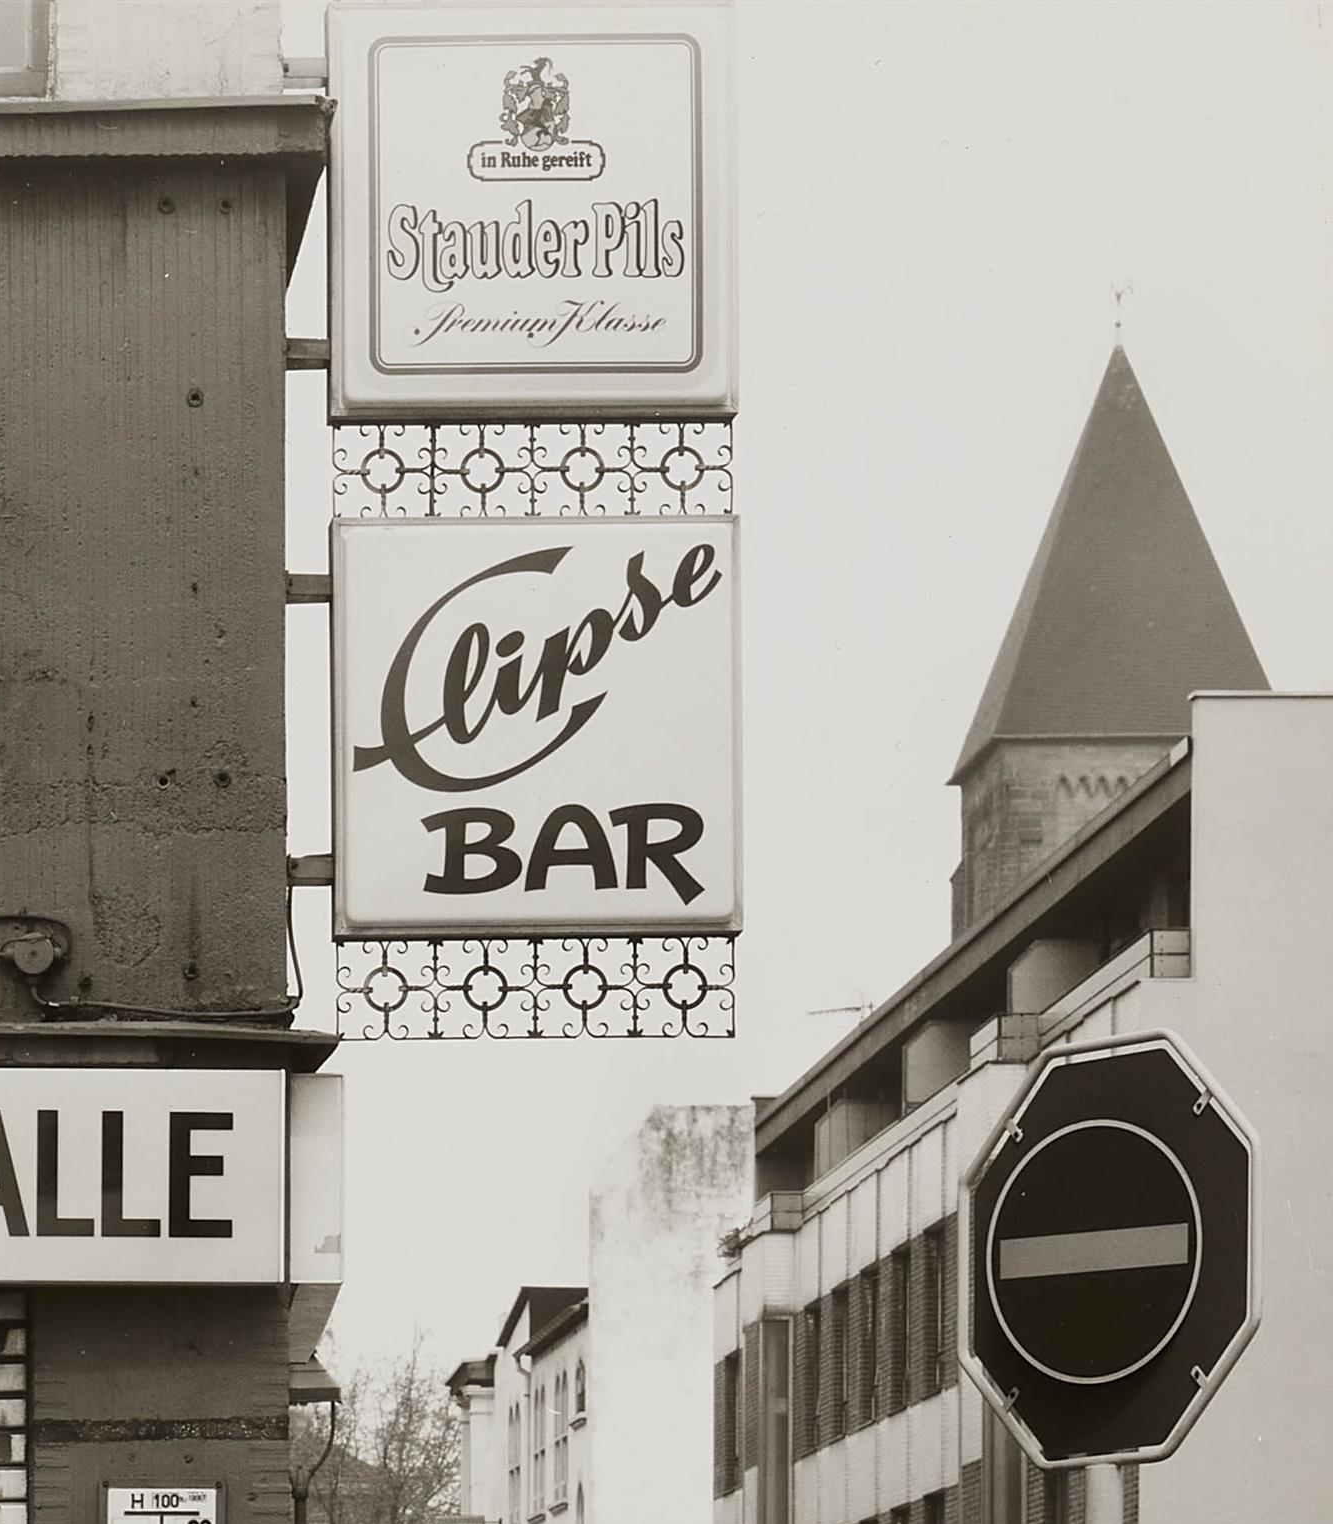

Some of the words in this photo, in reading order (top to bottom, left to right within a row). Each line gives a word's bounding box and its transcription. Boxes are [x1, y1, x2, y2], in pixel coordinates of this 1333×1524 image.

[481, 152, 497, 167] in
[501, 151, 539, 167] Ruhe
[542, 151, 593, 172] gereift
[420, 803, 706, 906] BAR
[131, 1493, 144, 1508] H
[154, 1494, 179, 1508] 100
